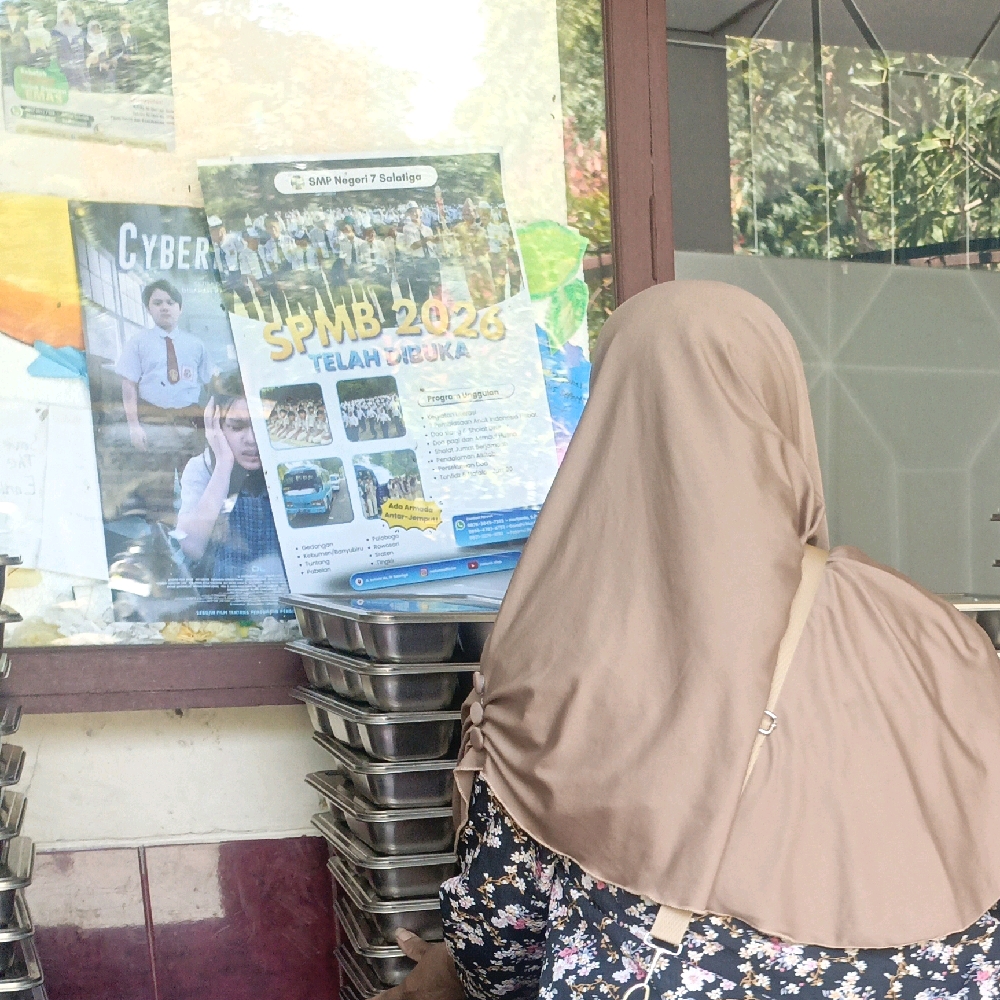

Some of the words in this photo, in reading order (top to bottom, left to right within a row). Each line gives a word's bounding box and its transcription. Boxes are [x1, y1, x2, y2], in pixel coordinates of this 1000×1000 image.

[308, 176, 332, 187] SMP
[334, 174, 368, 187] Negeri
[369, 174, 377, 183] 7
[379, 172, 422, 184] Salatiga
[119, 221, 218, 270] CYBER
[262, 299, 384, 362] SPMB
[391, 298, 507, 342] 2026
[308, 348, 381, 374] TELAH
[386, 341, 472, 366] DIBUKA
[388, 502, 404, 510] Ada
[404, 503, 434, 514] Armada
